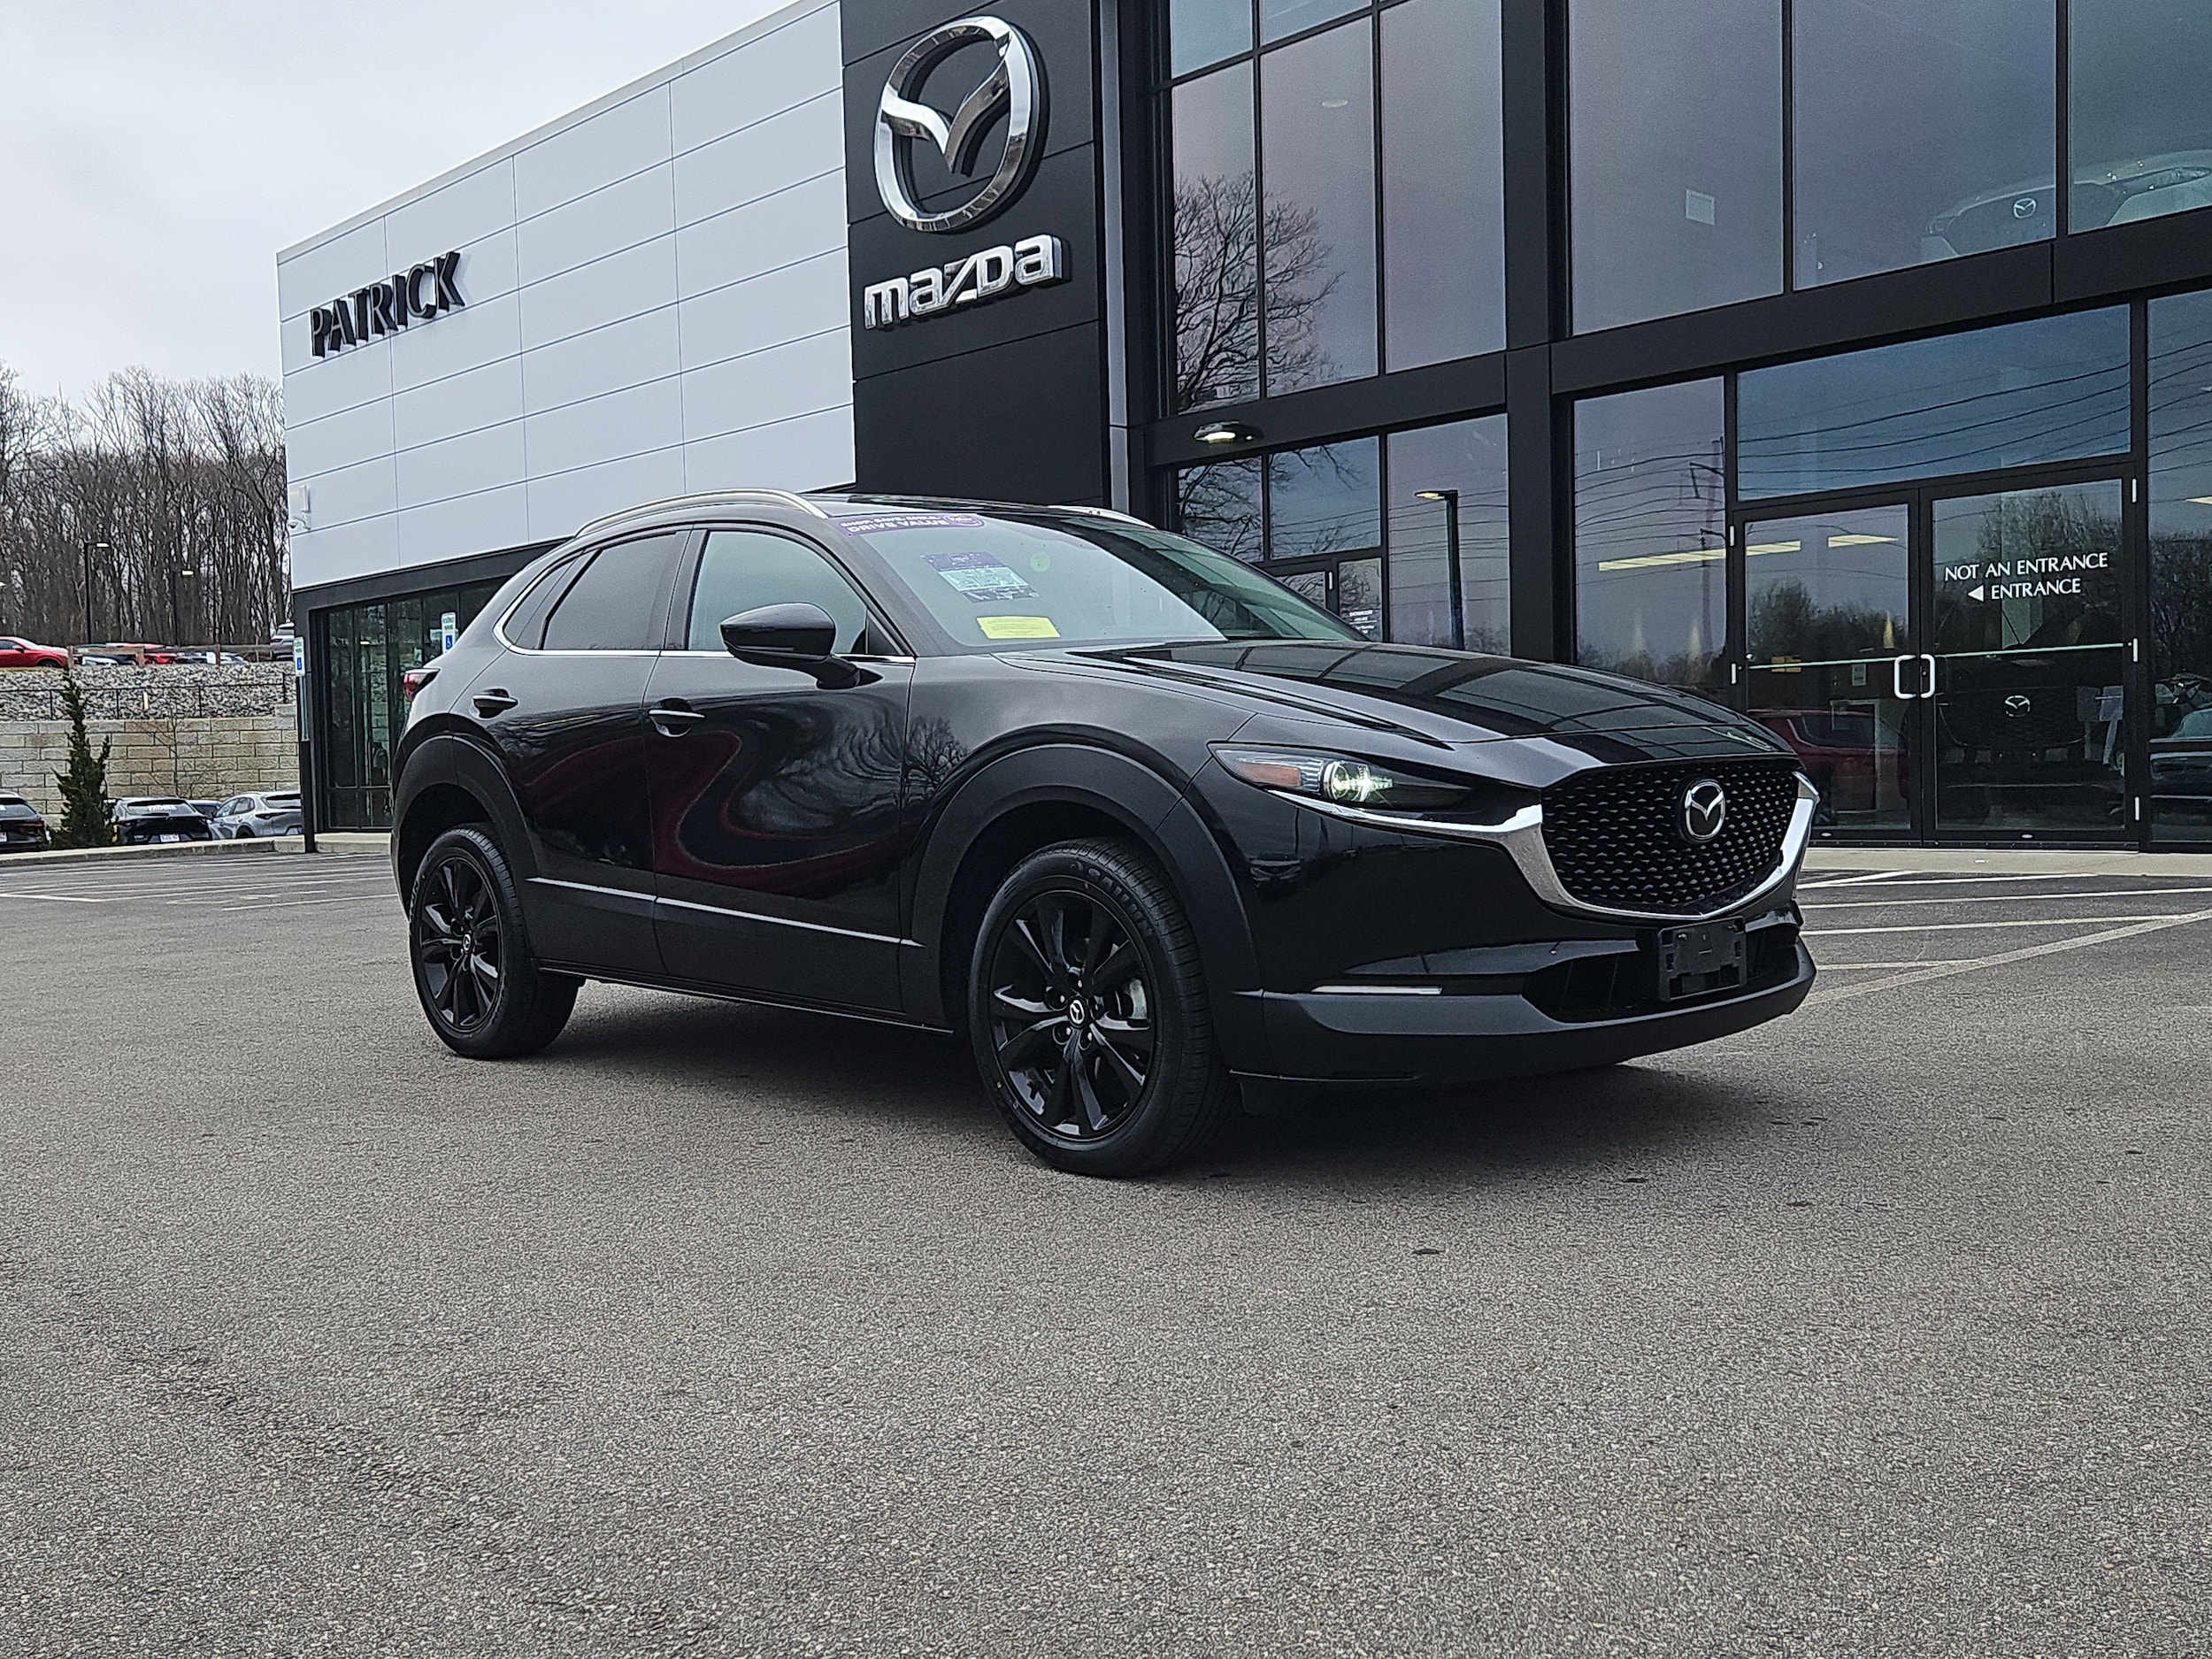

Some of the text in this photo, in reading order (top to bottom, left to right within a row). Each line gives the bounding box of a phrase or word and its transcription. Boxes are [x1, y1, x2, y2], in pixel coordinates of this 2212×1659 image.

[864, 234, 1063, 330] mazda
[311, 250, 465, 358] PATRICK
[847, 521, 898, 533] DRIVE
[896, 518, 950, 527] VALUE
[1945, 552, 2108, 581] NOT AN ENTRANCE
[1991, 578, 2082, 600] ENTRANCE
